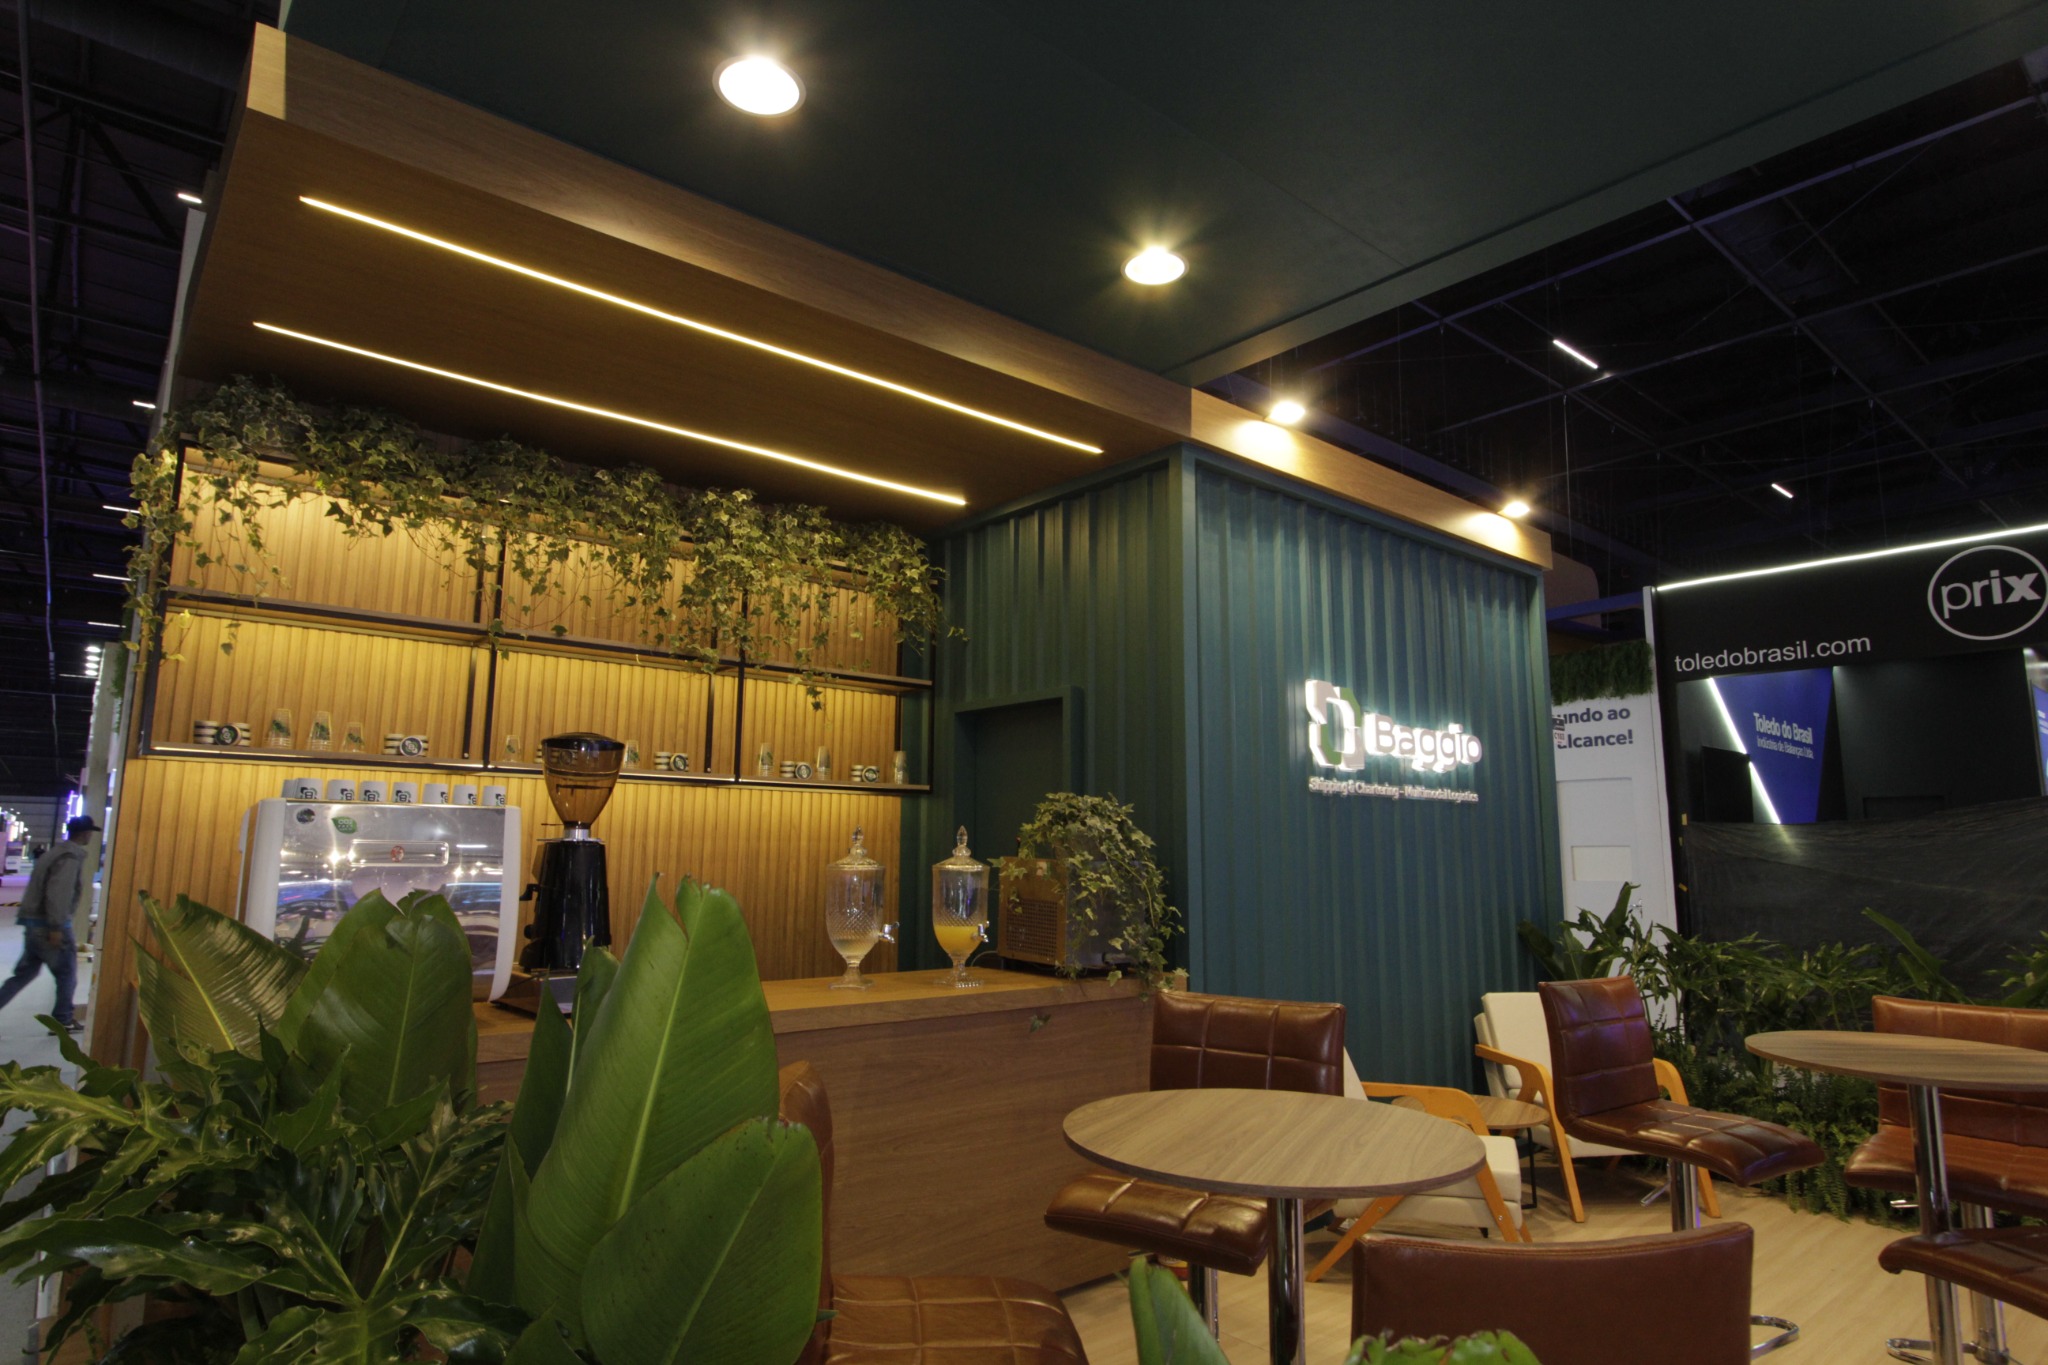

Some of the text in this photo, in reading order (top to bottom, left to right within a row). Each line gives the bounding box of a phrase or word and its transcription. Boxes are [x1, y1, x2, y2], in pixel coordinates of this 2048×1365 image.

[1941, 569, 2042, 620] prix
[1674, 636, 1872, 673] toledobrasil.com
[1607, 708, 1631, 721] ao
[1753, 712, 1813, 745] Toledo do Brasil
[1363, 712, 1482, 773] Baggio
[1308, 776, 1348, 798] Shipping
[1355, 781, 1400, 800] Chartering
